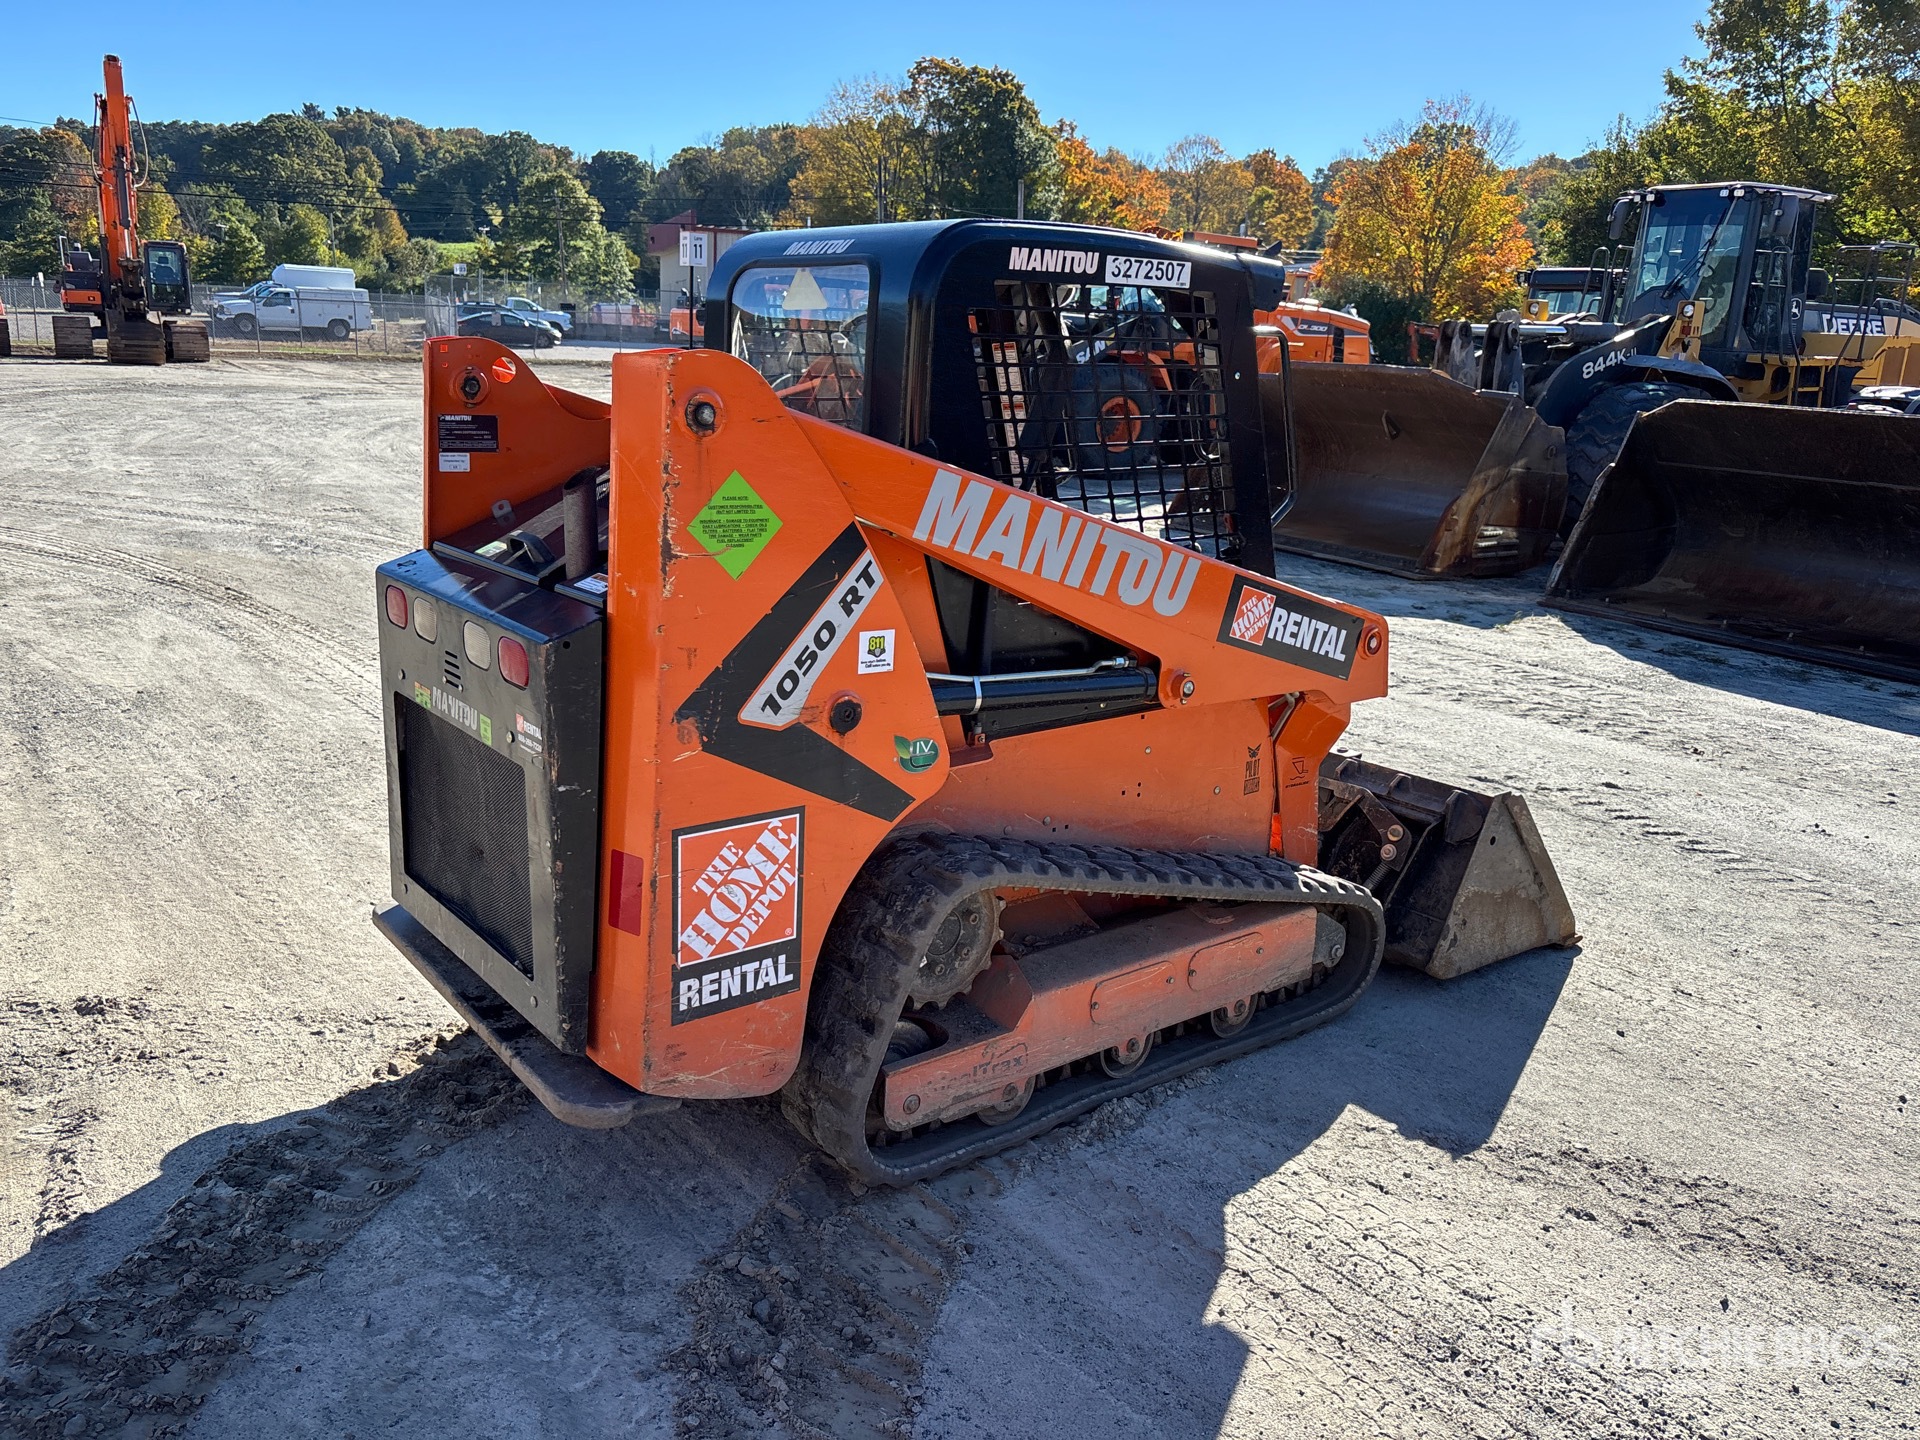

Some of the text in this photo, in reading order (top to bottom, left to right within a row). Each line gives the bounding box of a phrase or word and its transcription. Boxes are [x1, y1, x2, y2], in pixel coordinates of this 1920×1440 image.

[682, 243, 688, 258] 11
[694, 244, 702, 258] 11
[783, 238, 855, 255] MANITOU
[1008, 246, 1100, 274] MANITOU
[1111, 257, 1186, 282] 3272507
[1822, 314, 1884, 335] DEERE
[912, 468, 1202, 617] MANITOU
[1232, 594, 1275, 638] HOME
[1241, 595, 1258, 612] THE
[761, 559, 876, 716] 1050 RT
[1244, 613, 1270, 640] DEPOT
[1268, 606, 1347, 662] RENTAL
[870, 636, 884, 650] 811
[432, 686, 477, 730] MANITOU
[524, 720, 542, 740] RENTAL
[692, 841, 743, 897] THE
[681, 818, 798, 959] HOME
[726, 863, 796, 950] DEPOT
[679, 954, 794, 1012] RENTAL
